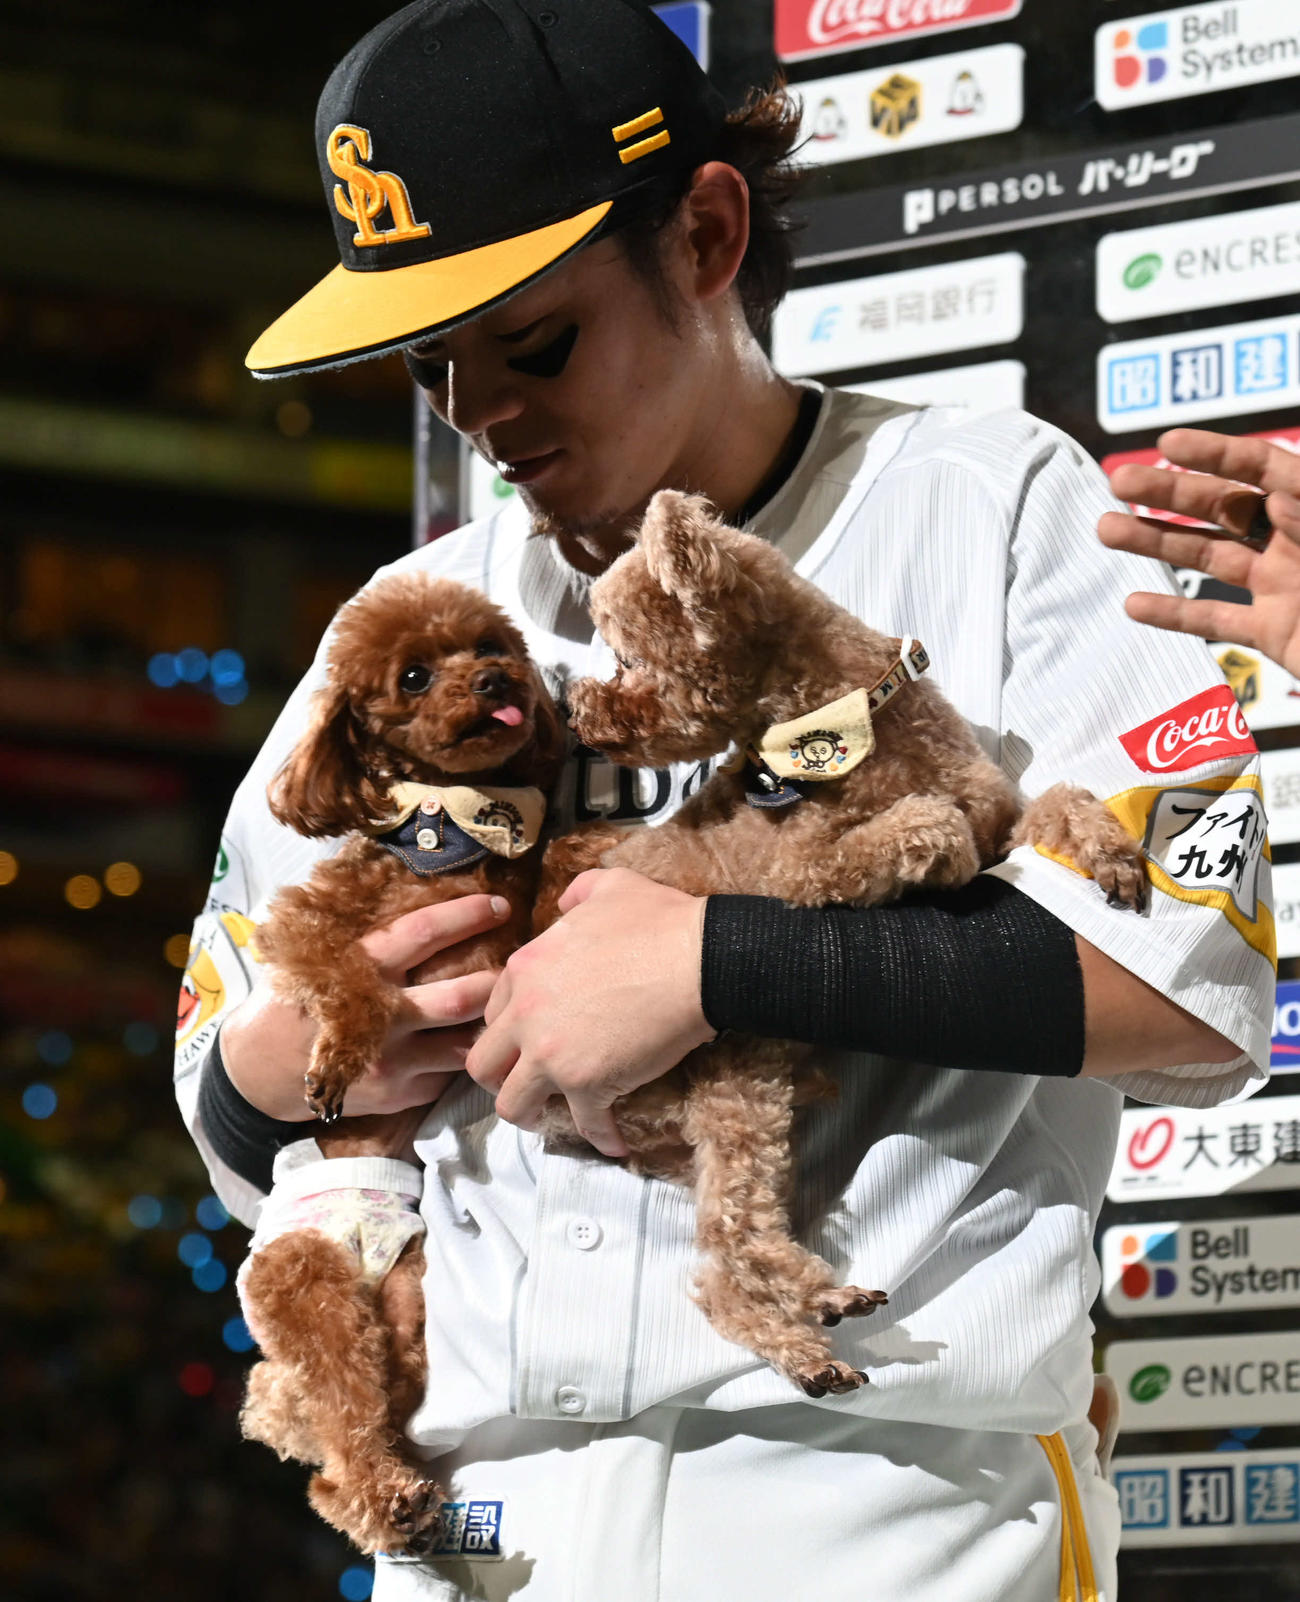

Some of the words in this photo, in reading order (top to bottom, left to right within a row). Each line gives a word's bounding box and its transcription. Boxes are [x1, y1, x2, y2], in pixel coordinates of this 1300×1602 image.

[1181, 8, 1239, 44] Bell
[1181, 37, 1298, 82] System
[937, 171, 1065, 215] PERSOL
[1146, 701, 1250, 768] Coca-C
[1170, 843, 1248, 893] 九州
[1190, 1226, 1248, 1261] Bell
